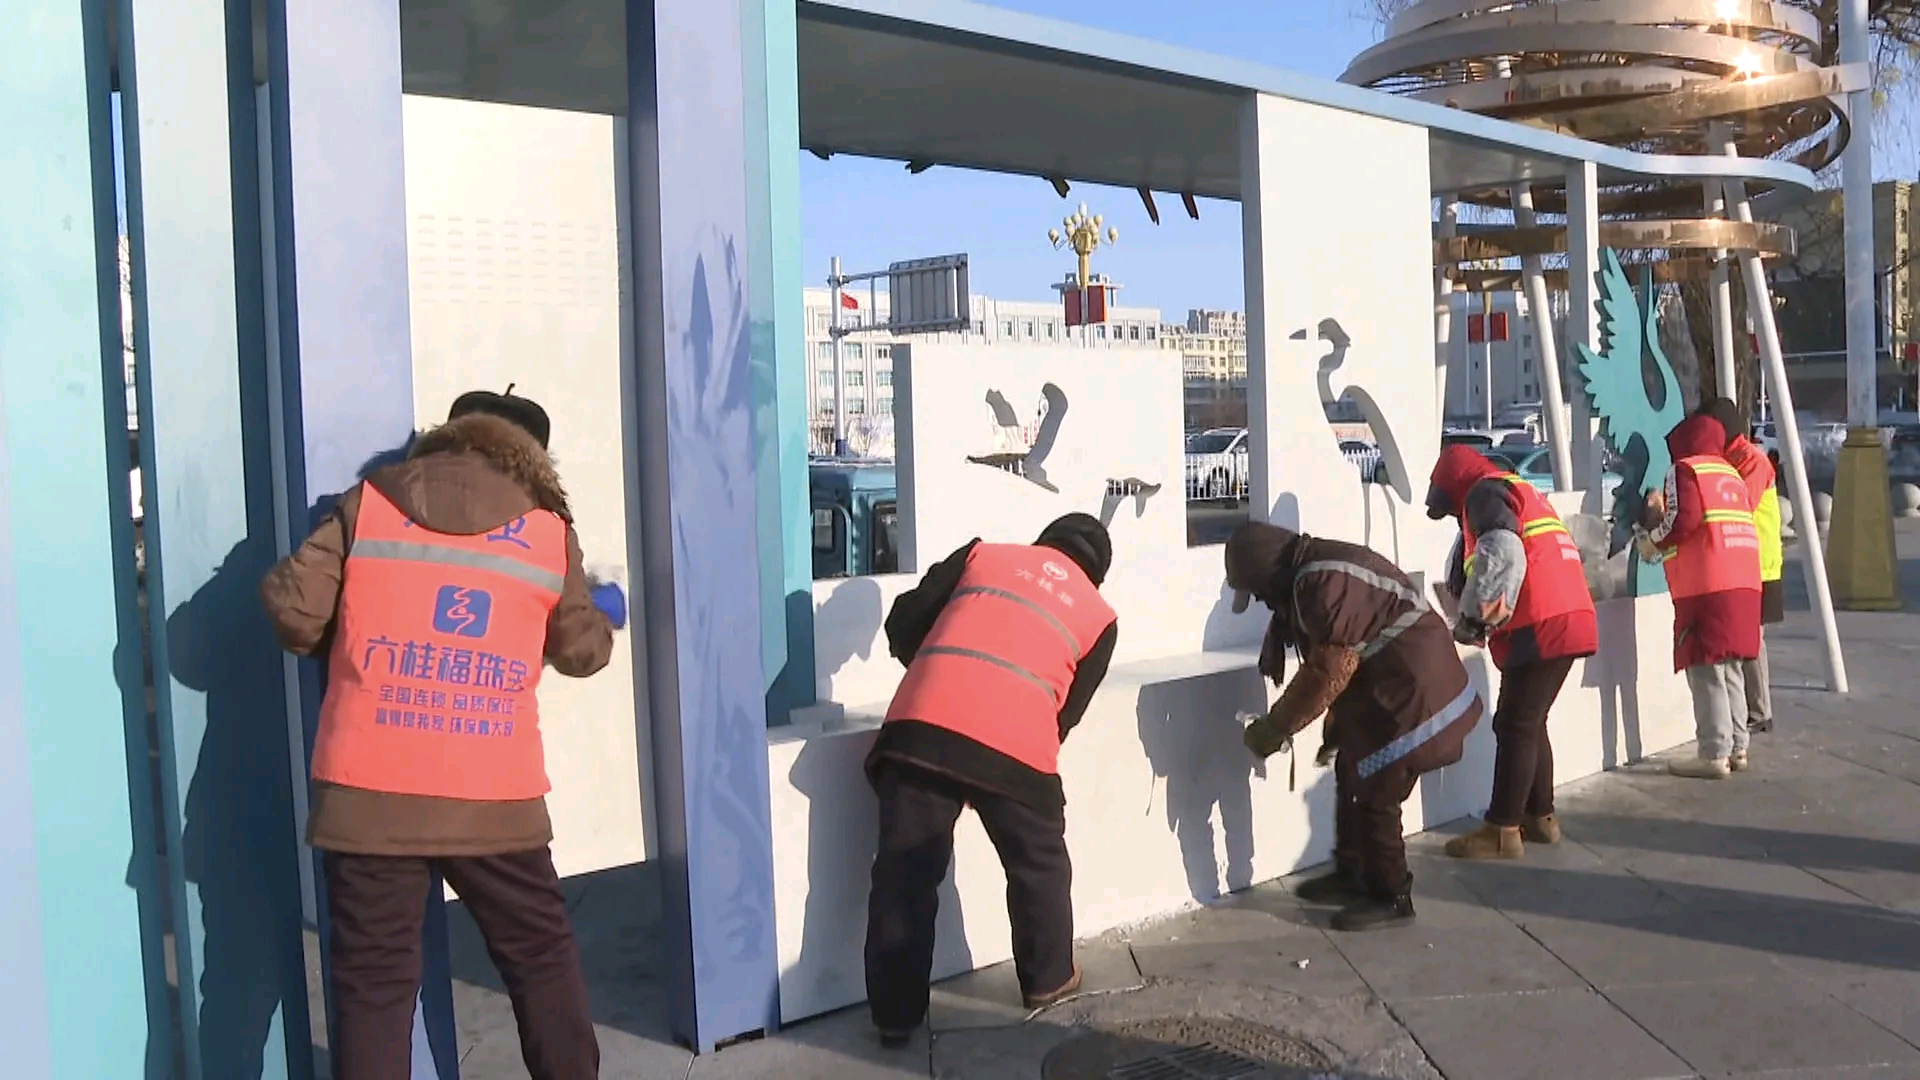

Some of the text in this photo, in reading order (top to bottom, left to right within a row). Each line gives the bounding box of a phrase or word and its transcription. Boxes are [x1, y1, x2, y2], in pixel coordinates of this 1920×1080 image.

[363, 635, 527, 693] 六桂福珠宝
[379, 685, 446, 709] 全国连锁
